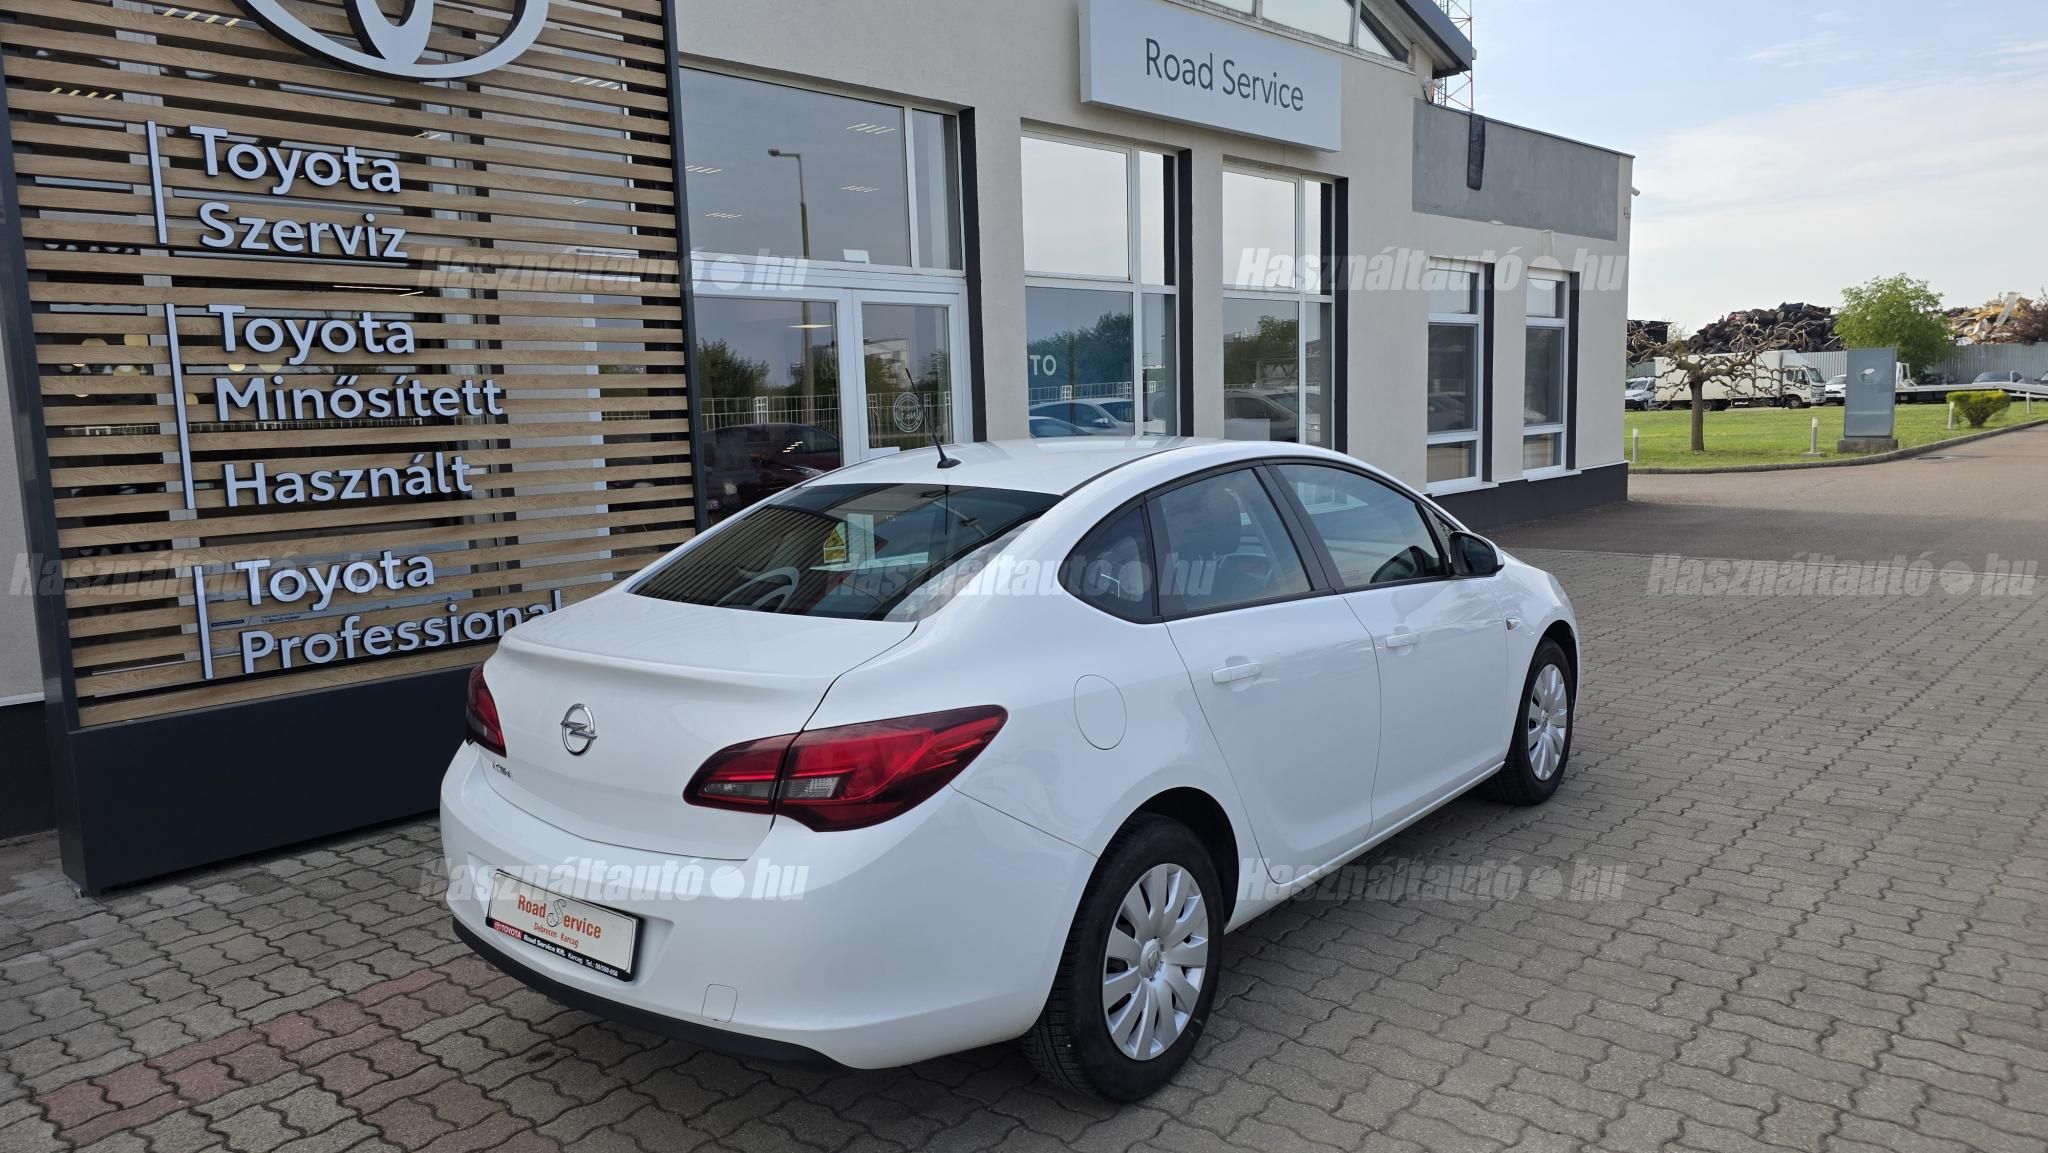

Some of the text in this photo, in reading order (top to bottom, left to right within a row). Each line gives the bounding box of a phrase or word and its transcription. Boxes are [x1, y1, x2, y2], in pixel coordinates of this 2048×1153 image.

[1146, 38, 1304, 111] Road Service
[188, 125, 401, 195] Toyota
[199, 201, 408, 258] Szerviz
[207, 304, 415, 365] Toyota
[214, 375, 503, 422] Minősített
[224, 451, 473, 508] Használt
[232, 550, 435, 611] Toyota
[500, 925, 522, 940] TOYOTA
[517, 894, 547, 919] Road
[533, 922, 557, 939] Debrecen
[560, 933, 579, 948] Karcag
